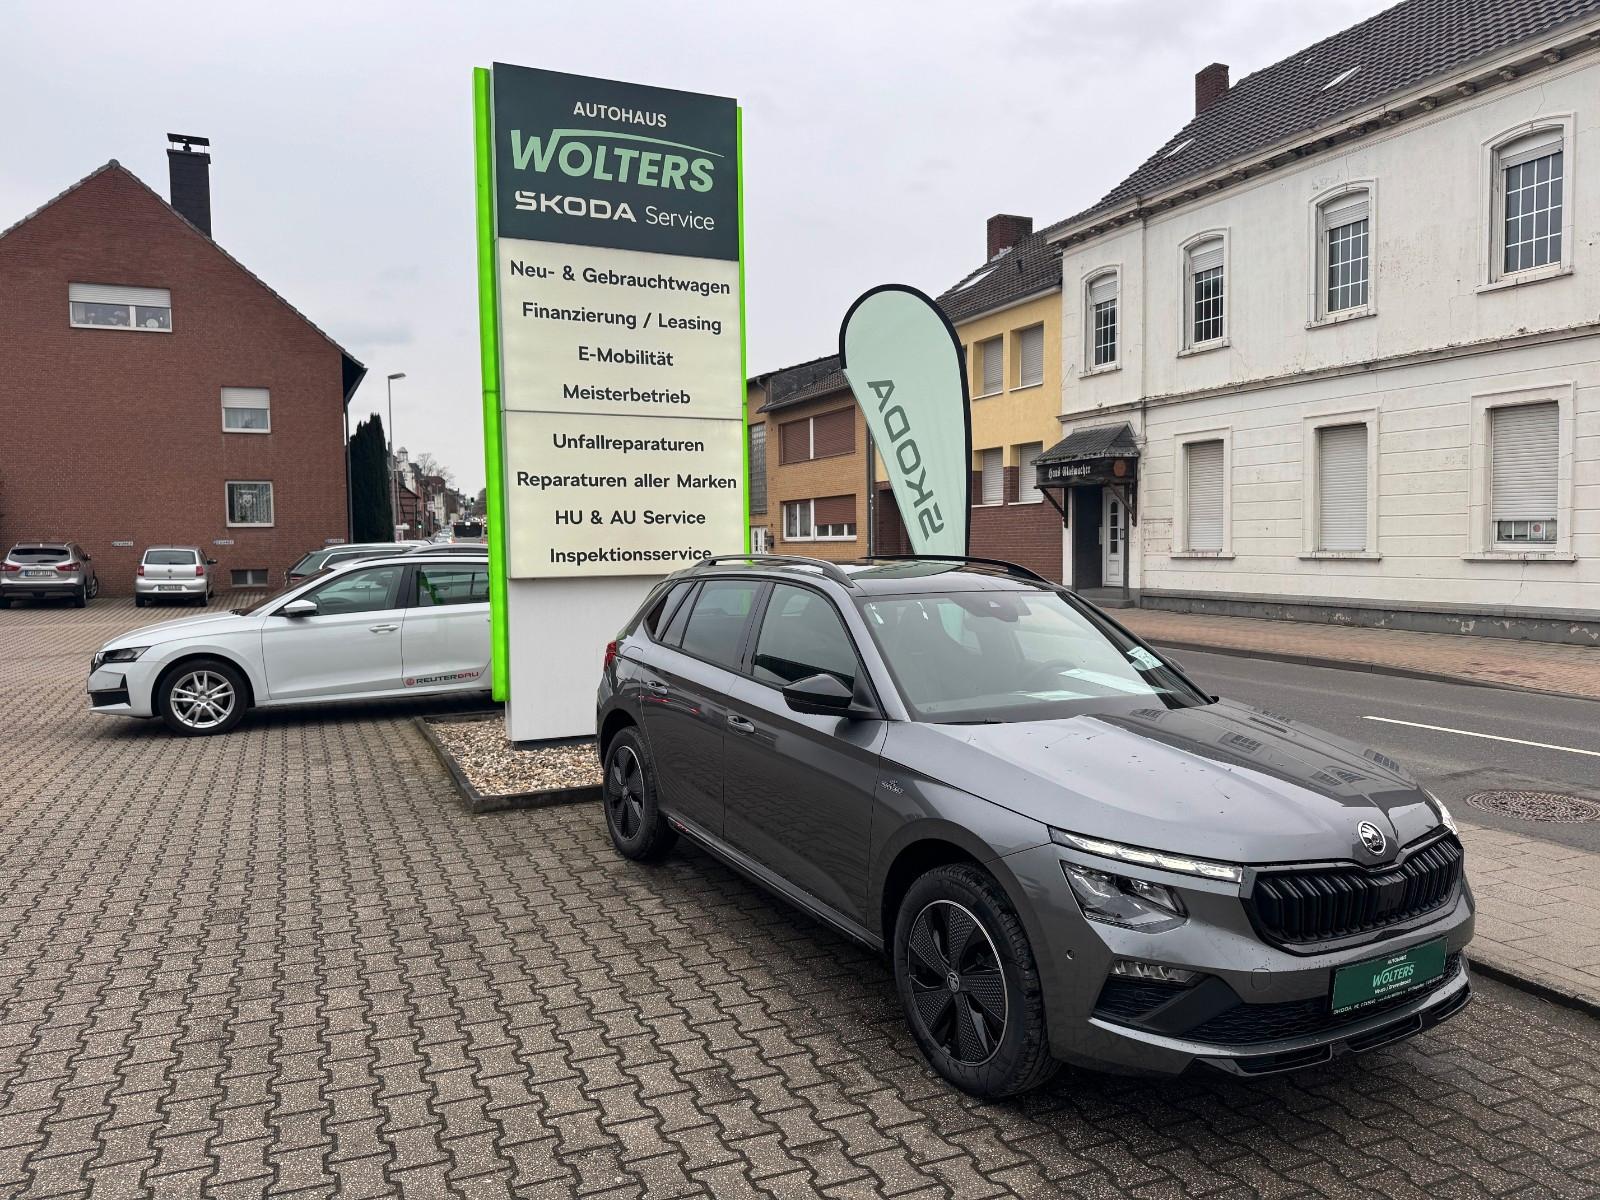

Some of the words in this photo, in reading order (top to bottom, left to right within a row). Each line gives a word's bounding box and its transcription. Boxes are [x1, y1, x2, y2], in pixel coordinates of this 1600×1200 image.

[573, 101, 667, 128] AUTOHAUS
[510, 128, 716, 193] WOLTERS
[645, 206, 715, 231] Service
[510, 260, 555, 279] Neu-
[562, 265, 576, 281] &
[583, 267, 731, 296] Gebrauchtwagen
[522, 301, 637, 330] Finanzierung
[643, 312, 652, 329] /
[658, 313, 722, 335] Leasing
[578, 345, 674, 366] E-Mobilität
[563, 384, 691, 404] Meisterbetrieb
[553, 433, 705, 453] Unfallreparaturen
[517, 471, 627, 490] Reparaturen
[634, 473, 670, 488] aller
[677, 474, 737, 489] Marken
[555, 510, 583, 525] HU
[590, 510, 603, 525] &
[610, 510, 636, 525] AU
[643, 509, 706, 525] Service
[550, 547, 712, 566] Inspektionsservice
[1372, 963, 1415, 987] WOLTERS
